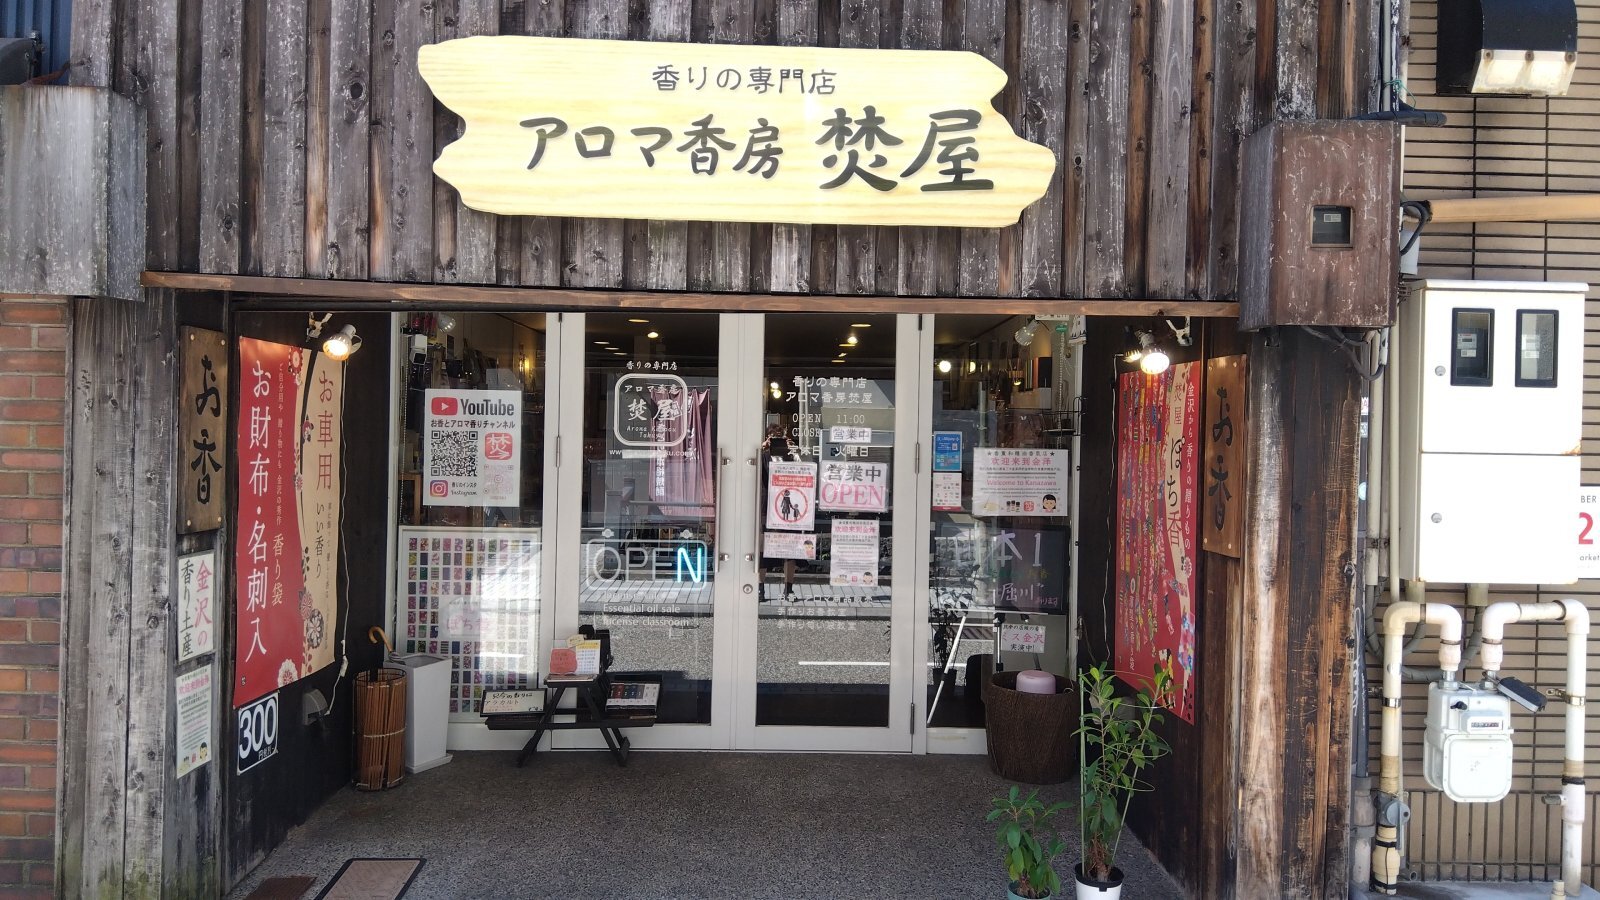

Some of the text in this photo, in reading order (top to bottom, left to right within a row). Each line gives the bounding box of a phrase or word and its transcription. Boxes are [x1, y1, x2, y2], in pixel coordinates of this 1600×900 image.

[652, 65, 838, 95] 香りの専門店
[519, 105, 996, 192] アロマ香房 焚屋
[625, 361, 678, 371] 香りの専門店
[792, 375, 868, 389] 香りの専門店
[459, 398, 515, 416] YouTube
[785, 391, 873, 404] アロマ香房焚屋
[627, 398, 676, 421] 焚屋
[792, 413, 865, 424] OPEN 11:00
[190, 354, 223, 505] お香
[430, 419, 516, 429] お香とアロマ香りチャンネル
[791, 428, 820, 437] CLOSE
[832, 428, 870, 441] 営業中
[787, 445, 869, 457] 定休日 火曜日
[1208, 386, 1234, 532] お香
[314, 370, 335, 579] お車用 いい香り
[827, 463, 881, 483] 営業中
[821, 483, 884, 507] OPEN
[593, 546, 703, 583] OPEN
[179, 558, 196, 658] 香り土産
[194, 559, 213, 648] 金沢の
[603, 604, 681, 613] Essential oil sale
[642, 617, 690, 626] classroom
[239, 698, 277, 759] 300
